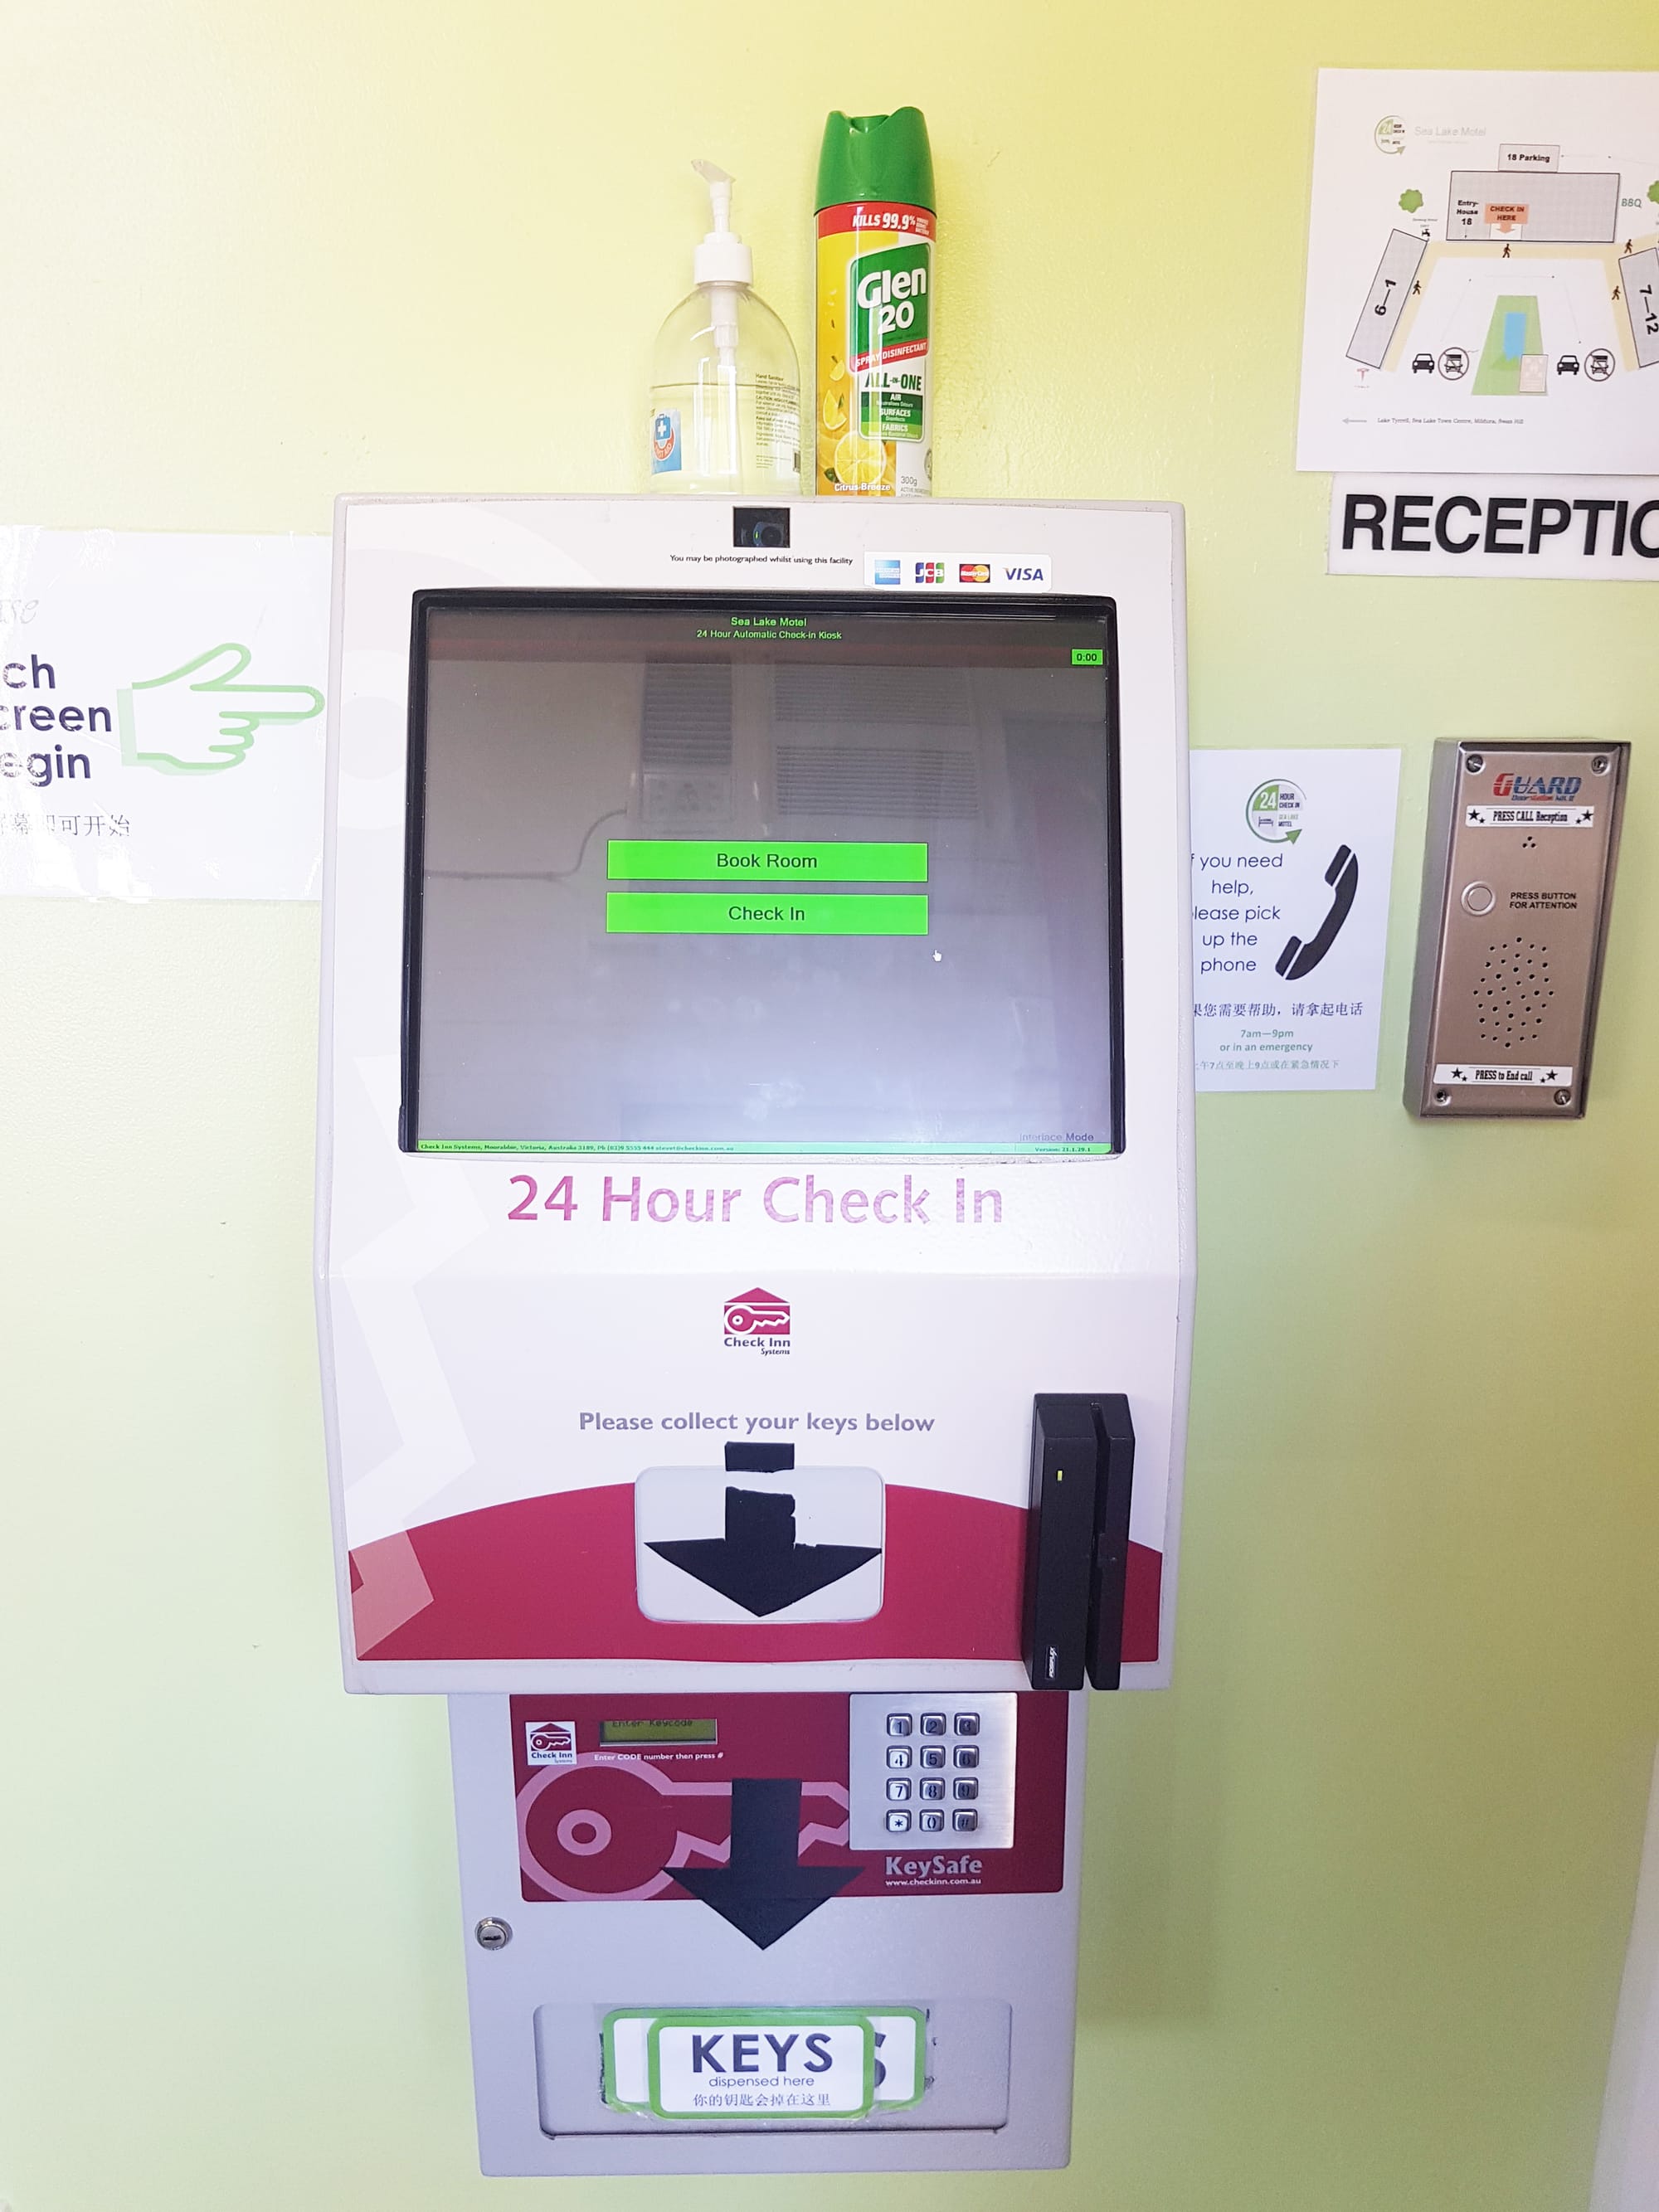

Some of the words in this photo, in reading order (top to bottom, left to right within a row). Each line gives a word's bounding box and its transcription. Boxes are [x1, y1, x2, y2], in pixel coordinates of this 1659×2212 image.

[1414, 126, 1432, 136] Sea
[1435, 127, 1457, 136] Lake
[1461, 127, 1486, 136] Motel
[1520, 154, 1550, 163] Parking
[1621, 198, 1642, 208] BBQ
[853, 214, 882, 227] KILLS
[882, 212, 916, 231] 99.9%
[858, 267, 927, 309] Glen
[878, 300, 914, 334] 20
[882, 342, 927, 359] DISINFECTANT
[879, 408, 911, 417] SURFACES
[882, 423, 908, 432] FABRICS
[834, 484, 858, 492] Citrus
[860, 482, 891, 491] Breeze
[901, 476, 917, 486] 300g
[715, 555, 767, 563] photographed
[830, 557, 853, 566] facility
[1003, 567, 1044, 581] VISA
[731, 617, 750, 626] Sea
[753, 617, 776, 626] Lake
[780, 618, 807, 626] Motel
[696, 630, 708, 638] 24
[733, 630, 777, 639] Automatic
[819, 631, 842, 639] Kiosk
[1076, 653, 1097, 662] 0:00
[1493, 773, 1582, 797] GUARD
[1260, 791, 1277, 809] 24
[1493, 810, 1515, 822] PRESS
[1516, 811, 1534, 822] CALL
[1535, 811, 1568, 824] Reception
[717, 853, 761, 868] Book
[766, 853, 817, 868] Room
[1199, 856, 1231, 871] you
[1238, 853, 1283, 868] need
[1211, 879, 1253, 897] help,
[728, 906, 784, 921] Check
[791, 907, 805, 921] In
[1193, 905, 1239, 920] lease
[1245, 905, 1281, 923] pick
[1203, 935, 1224, 949] up
[1231, 931, 1258, 946] the
[1201, 957, 1257, 975] phone
[1219, 1043, 1230, 1052] or
[1233, 1043, 1242, 1052] in
[1244, 1043, 1257, 1052] an
[1259, 1043, 1313, 1053] emergency
[1475, 1070, 1497, 1080] PRESS
[1498, 1071, 1506, 1080] to
[1506, 1071, 1520, 1081] End
[1520, 1071, 1533, 1081] call
[1019, 1133, 1063, 1141] Interface
[1066, 1133, 1094, 1141] Mode
[508, 1174, 578, 1221] 24
[602, 1176, 742, 1223] Hour
[763, 1174, 931, 1224] Check
[956, 1178, 1002, 1223] In
[724, 1336, 765, 1347] Check
[770, 1337, 791, 1347] Inn
[761, 1348, 791, 1356] Systems
[580, 1412, 654, 1430] Please
[661, 1412, 738, 1430] collect
[745, 1417, 800, 1435] your
[807, 1412, 858, 1435] keys
[866, 1412, 935, 1432] below
[649, 1719, 693, 1728] Keycode
[897, 1721, 902, 1734] 1
[928, 1721, 937, 1733] 2
[695, 1753, 715, 1761] press
[928, 1753, 937, 1765] 5
[895, 1786, 903, 1798] 7
[928, 1785, 937, 1797] 8
[927, 1817, 936, 1830] 0
[885, 1855, 983, 1879] KeySafe
[885, 1877, 981, 1886] www.checkinn.com.au
[692, 2033, 833, 2073] KEYS
[708, 2076, 779, 2089] dispensed
[783, 2076, 815, 2087] here
[693, 2093, 830, 2107] 你的钥匙会掉在这里
